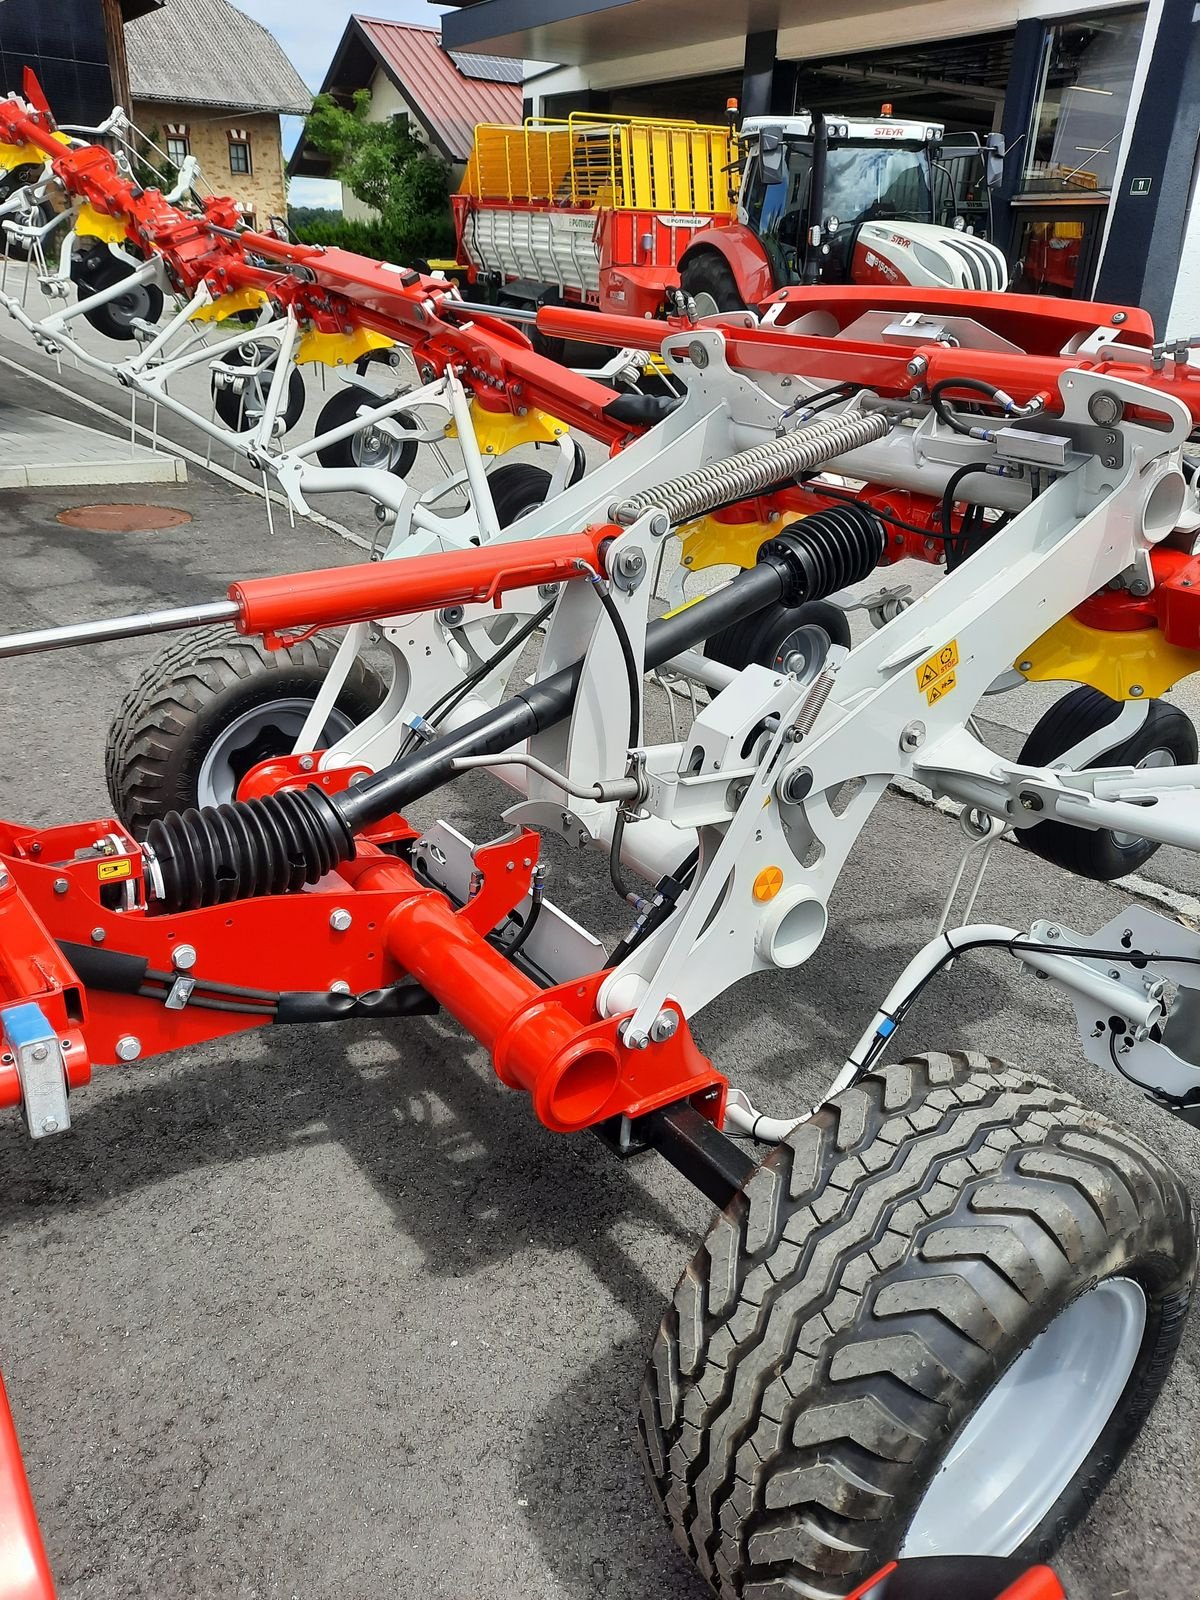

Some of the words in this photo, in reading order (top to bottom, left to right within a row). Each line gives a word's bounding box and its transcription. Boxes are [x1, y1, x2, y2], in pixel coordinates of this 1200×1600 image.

[874, 128, 904, 136] STEYR
[891, 234, 911, 248] STEYR
[940, 659, 956, 673] STOP
